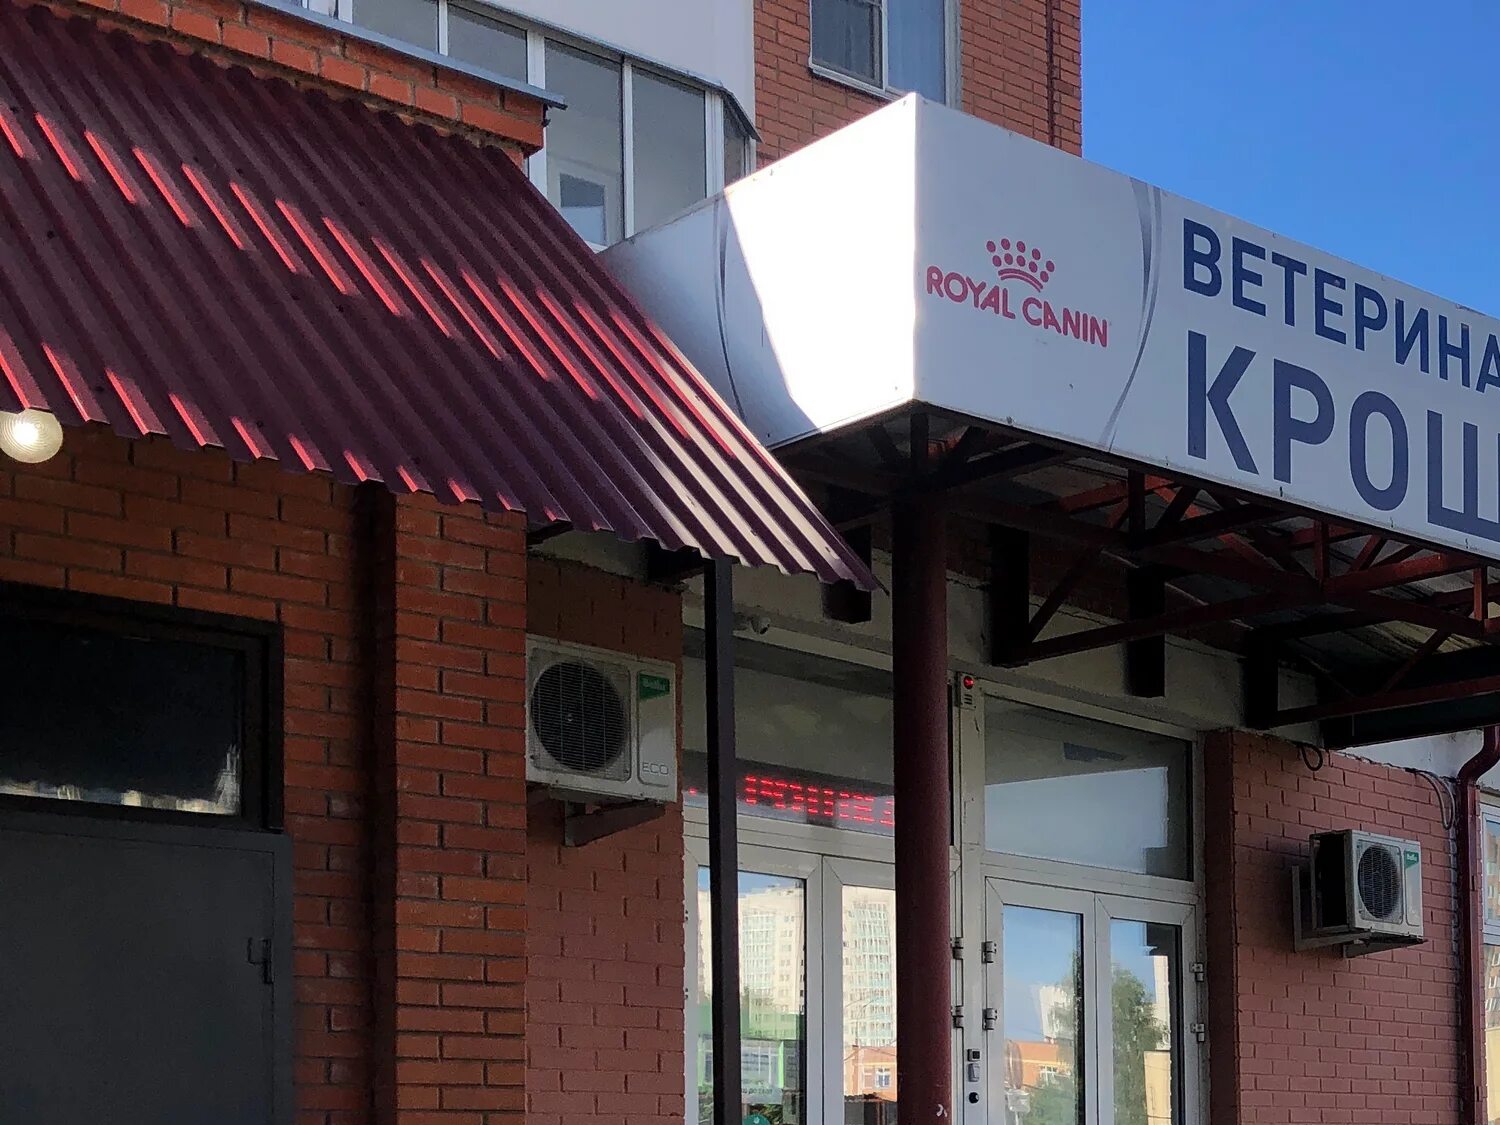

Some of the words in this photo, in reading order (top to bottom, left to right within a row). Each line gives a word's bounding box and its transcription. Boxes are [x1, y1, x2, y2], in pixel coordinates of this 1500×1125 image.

[926, 265, 1016, 320] ROYAL
[1022, 296, 1108, 348] CANIN
[642, 762, 669, 775] ECO
